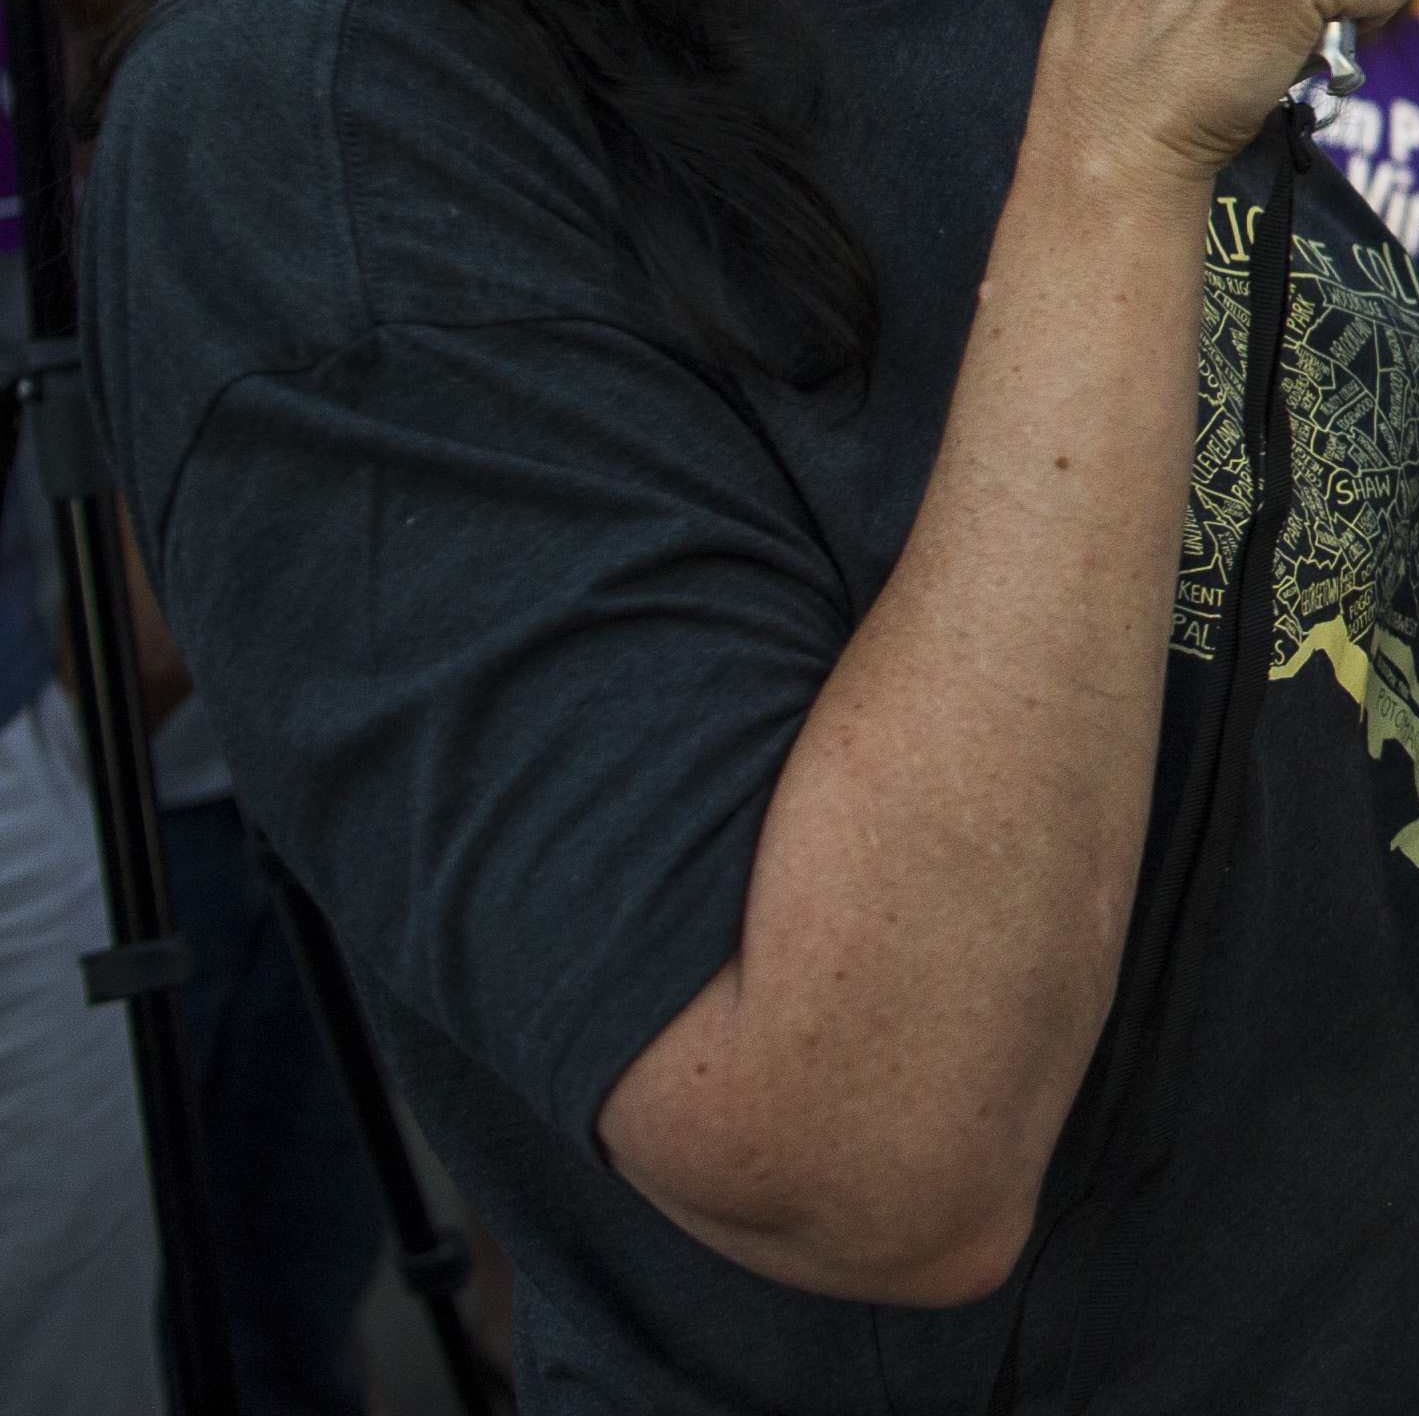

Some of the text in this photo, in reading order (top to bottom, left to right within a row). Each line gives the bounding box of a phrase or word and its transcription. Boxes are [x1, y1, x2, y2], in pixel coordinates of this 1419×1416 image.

[1285, 292, 1316, 336] PARK
[1336, 474, 1391, 505] SHAW
[1178, 580, 1225, 608] KENT
